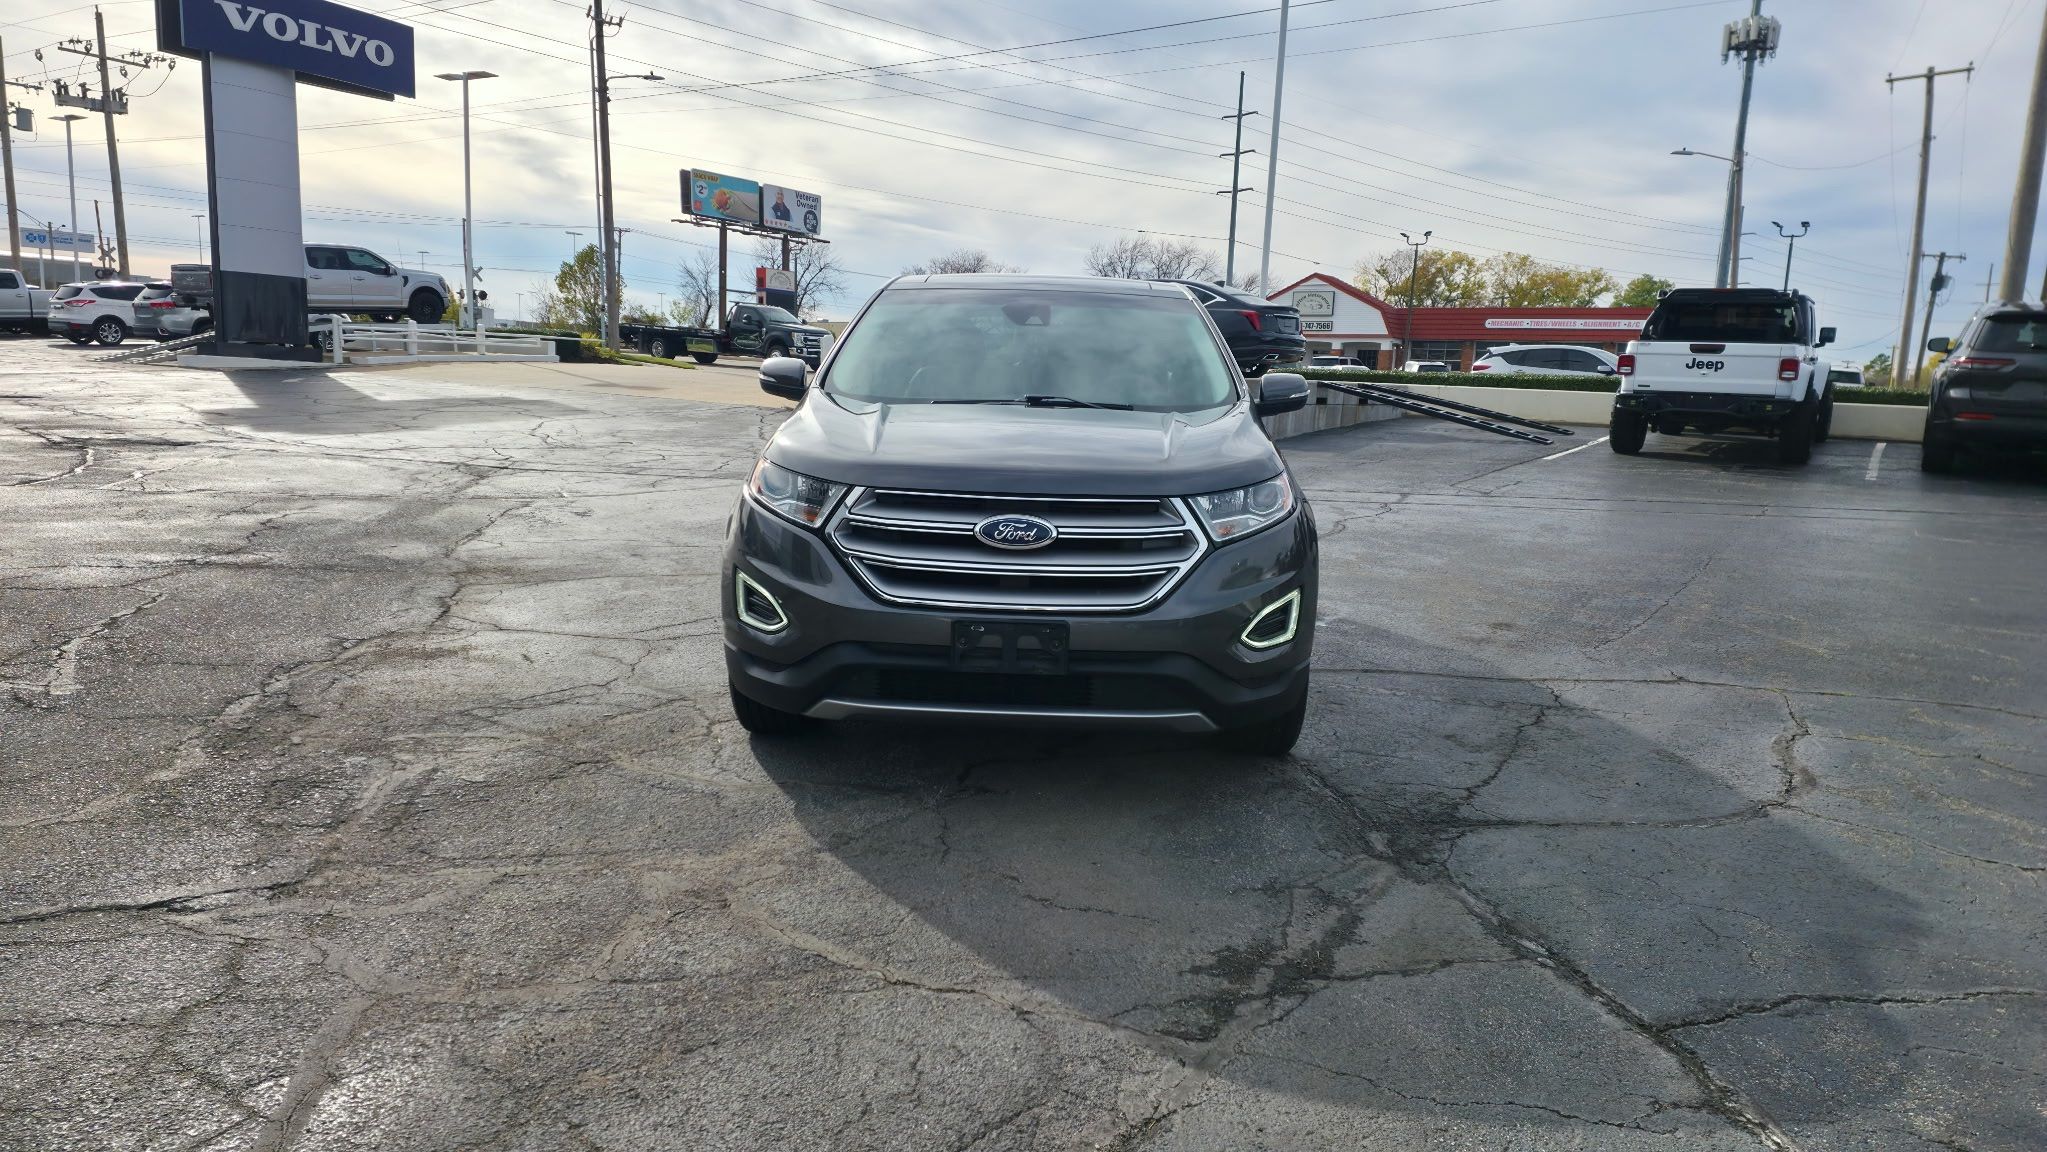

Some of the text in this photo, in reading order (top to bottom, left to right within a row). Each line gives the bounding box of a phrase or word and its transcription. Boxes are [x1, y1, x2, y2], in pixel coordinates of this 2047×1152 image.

[214, 0, 395, 67] VOLVO
[796, 191, 819, 203] Veteran
[797, 200, 818, 211] Owned
[1685, 357, 1725, 373] Jeep
[994, 522, 1038, 541] Ford
